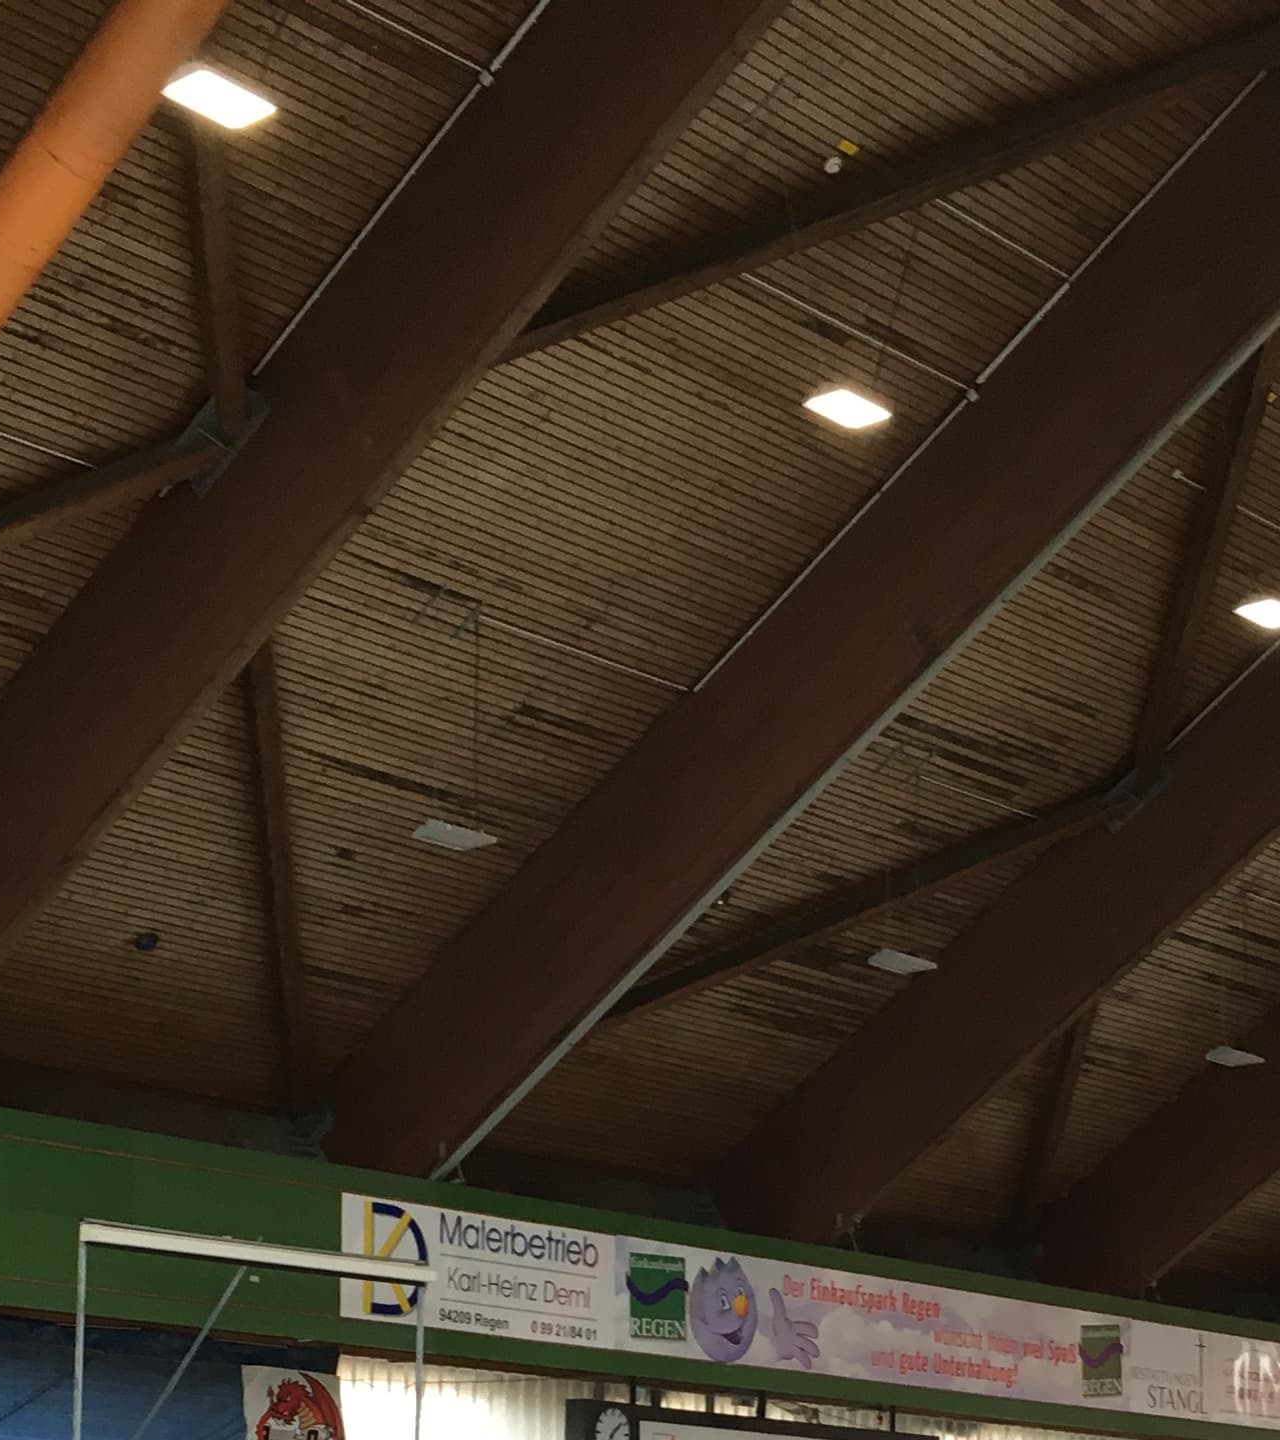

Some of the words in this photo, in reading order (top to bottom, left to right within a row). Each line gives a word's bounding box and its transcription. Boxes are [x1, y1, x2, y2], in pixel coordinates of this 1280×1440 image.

[439, 1212, 600, 1269] Malerbetrieb
[447, 1265, 537, 1301] Karl-Heinz
[543, 1280, 592, 1310] Deml
[782, 1273, 806, 1298] Der
[810, 1277, 897, 1313] Einkaufspark
[901, 1291, 941, 1322] Regen
[438, 1307, 472, 1325] 94209
[474, 1312, 510, 1331] Regen
[631, 1317, 686, 1338] REGEN
[870, 1347, 895, 1368] und
[898, 1350, 928, 1375] gute
[1147, 1384, 1209, 1415] STANGL
